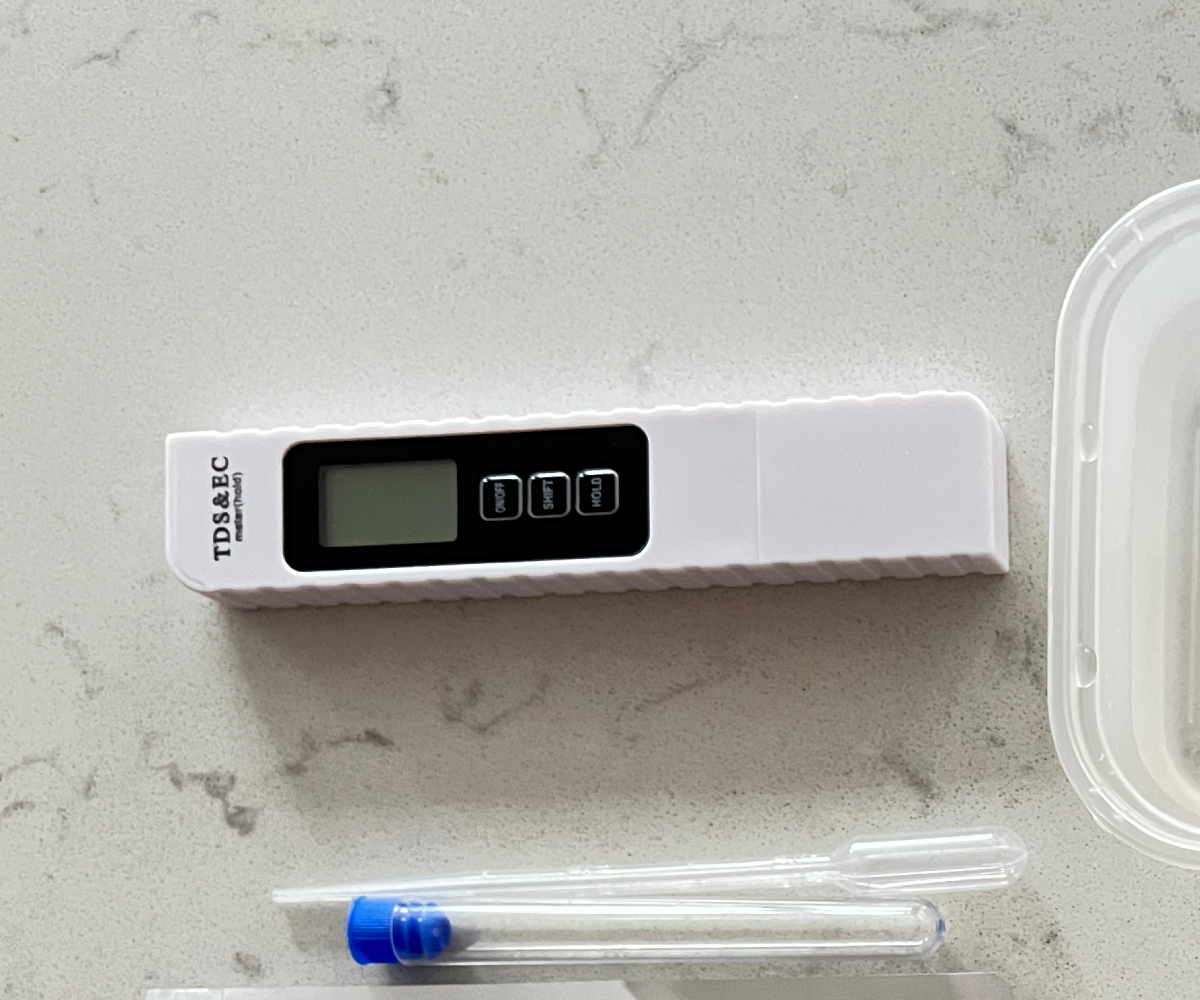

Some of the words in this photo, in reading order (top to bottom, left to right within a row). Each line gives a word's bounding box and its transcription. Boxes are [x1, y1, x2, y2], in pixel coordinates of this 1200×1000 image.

[542, 480, 554, 510] SHIFT
[590, 477, 602, 507] HOLD
[211, 455, 231, 561] TDS&EC
